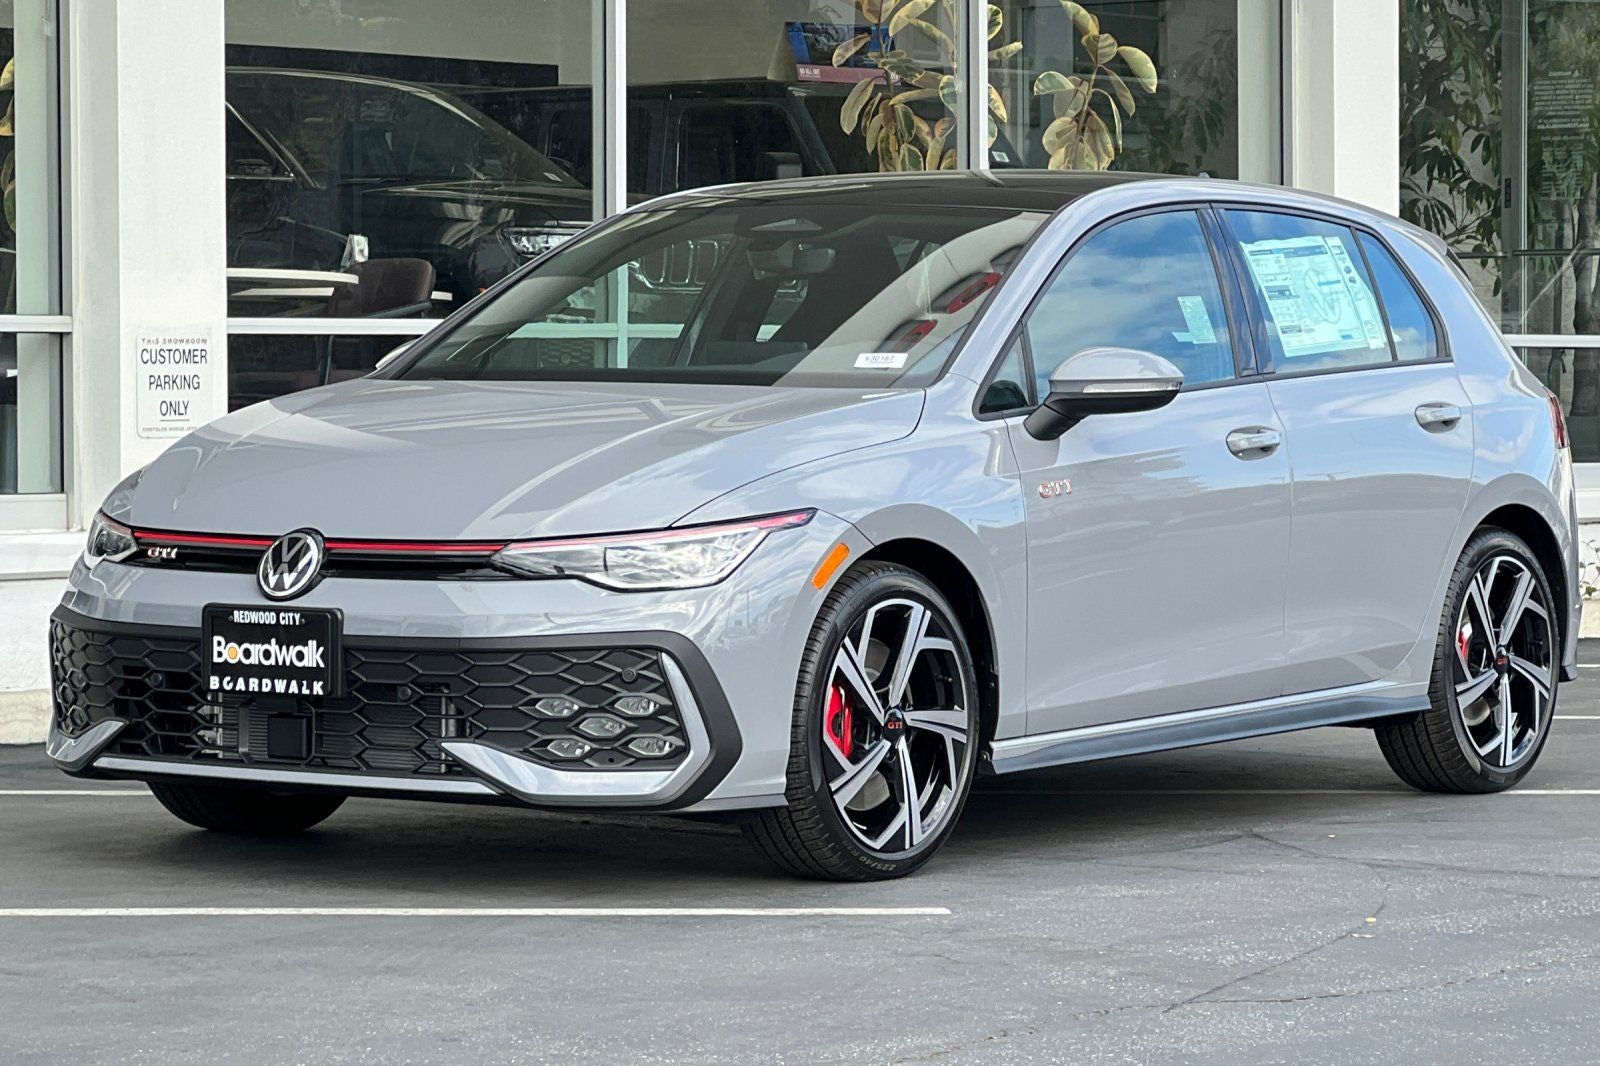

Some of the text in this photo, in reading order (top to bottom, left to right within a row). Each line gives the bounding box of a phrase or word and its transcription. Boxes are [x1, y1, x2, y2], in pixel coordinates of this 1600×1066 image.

[141, 337, 208, 345] THIS SHOWROOM
[140, 348, 208, 365] CUSTOMER
[148, 374, 201, 391] PARKING
[159, 400, 190, 417] ONLY
[233, 610, 301, 626] REDWOOD CITY
[212, 635, 325, 668] Boardwalk
[887, 721, 903, 730] GTI
